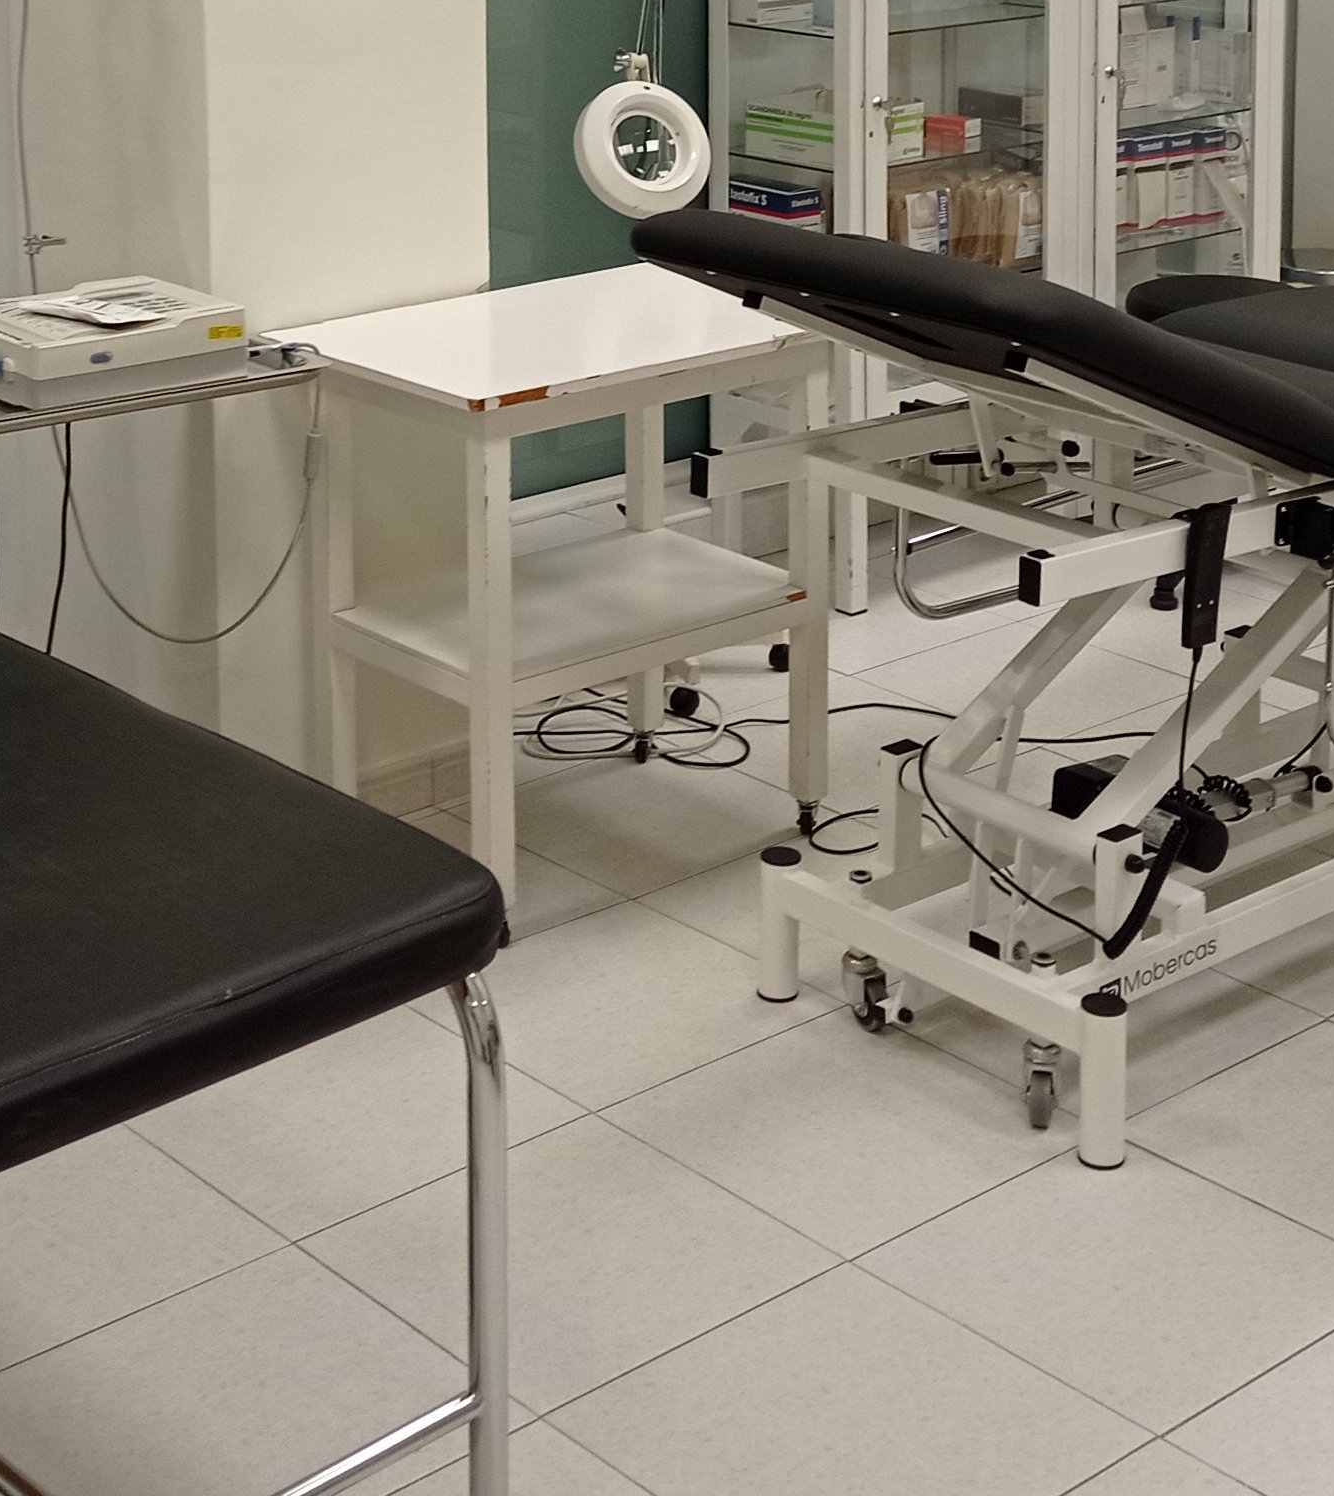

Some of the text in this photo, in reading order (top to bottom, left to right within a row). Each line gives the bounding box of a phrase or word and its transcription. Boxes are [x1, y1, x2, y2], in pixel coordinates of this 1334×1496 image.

[730, 188, 767, 206] lastofix S
[1123, 939, 1217, 995] Mobercas
